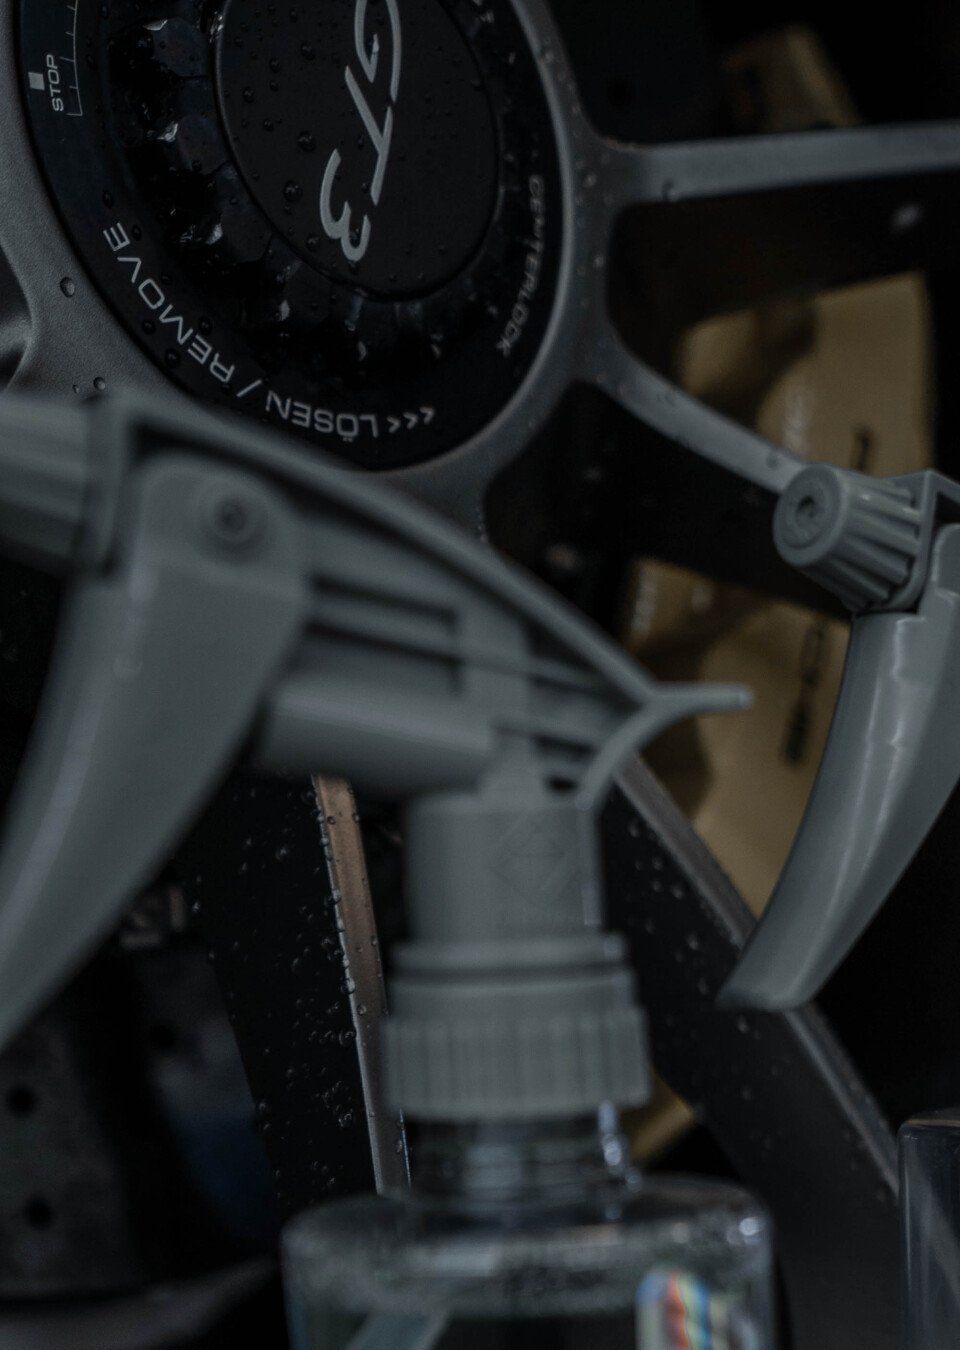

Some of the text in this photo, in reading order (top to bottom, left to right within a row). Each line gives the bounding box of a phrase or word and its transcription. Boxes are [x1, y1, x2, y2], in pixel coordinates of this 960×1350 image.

[46, 54, 64, 112] STOP
[319, 0, 402, 263] GT3
[103, 222, 235, 384] REMOVE
